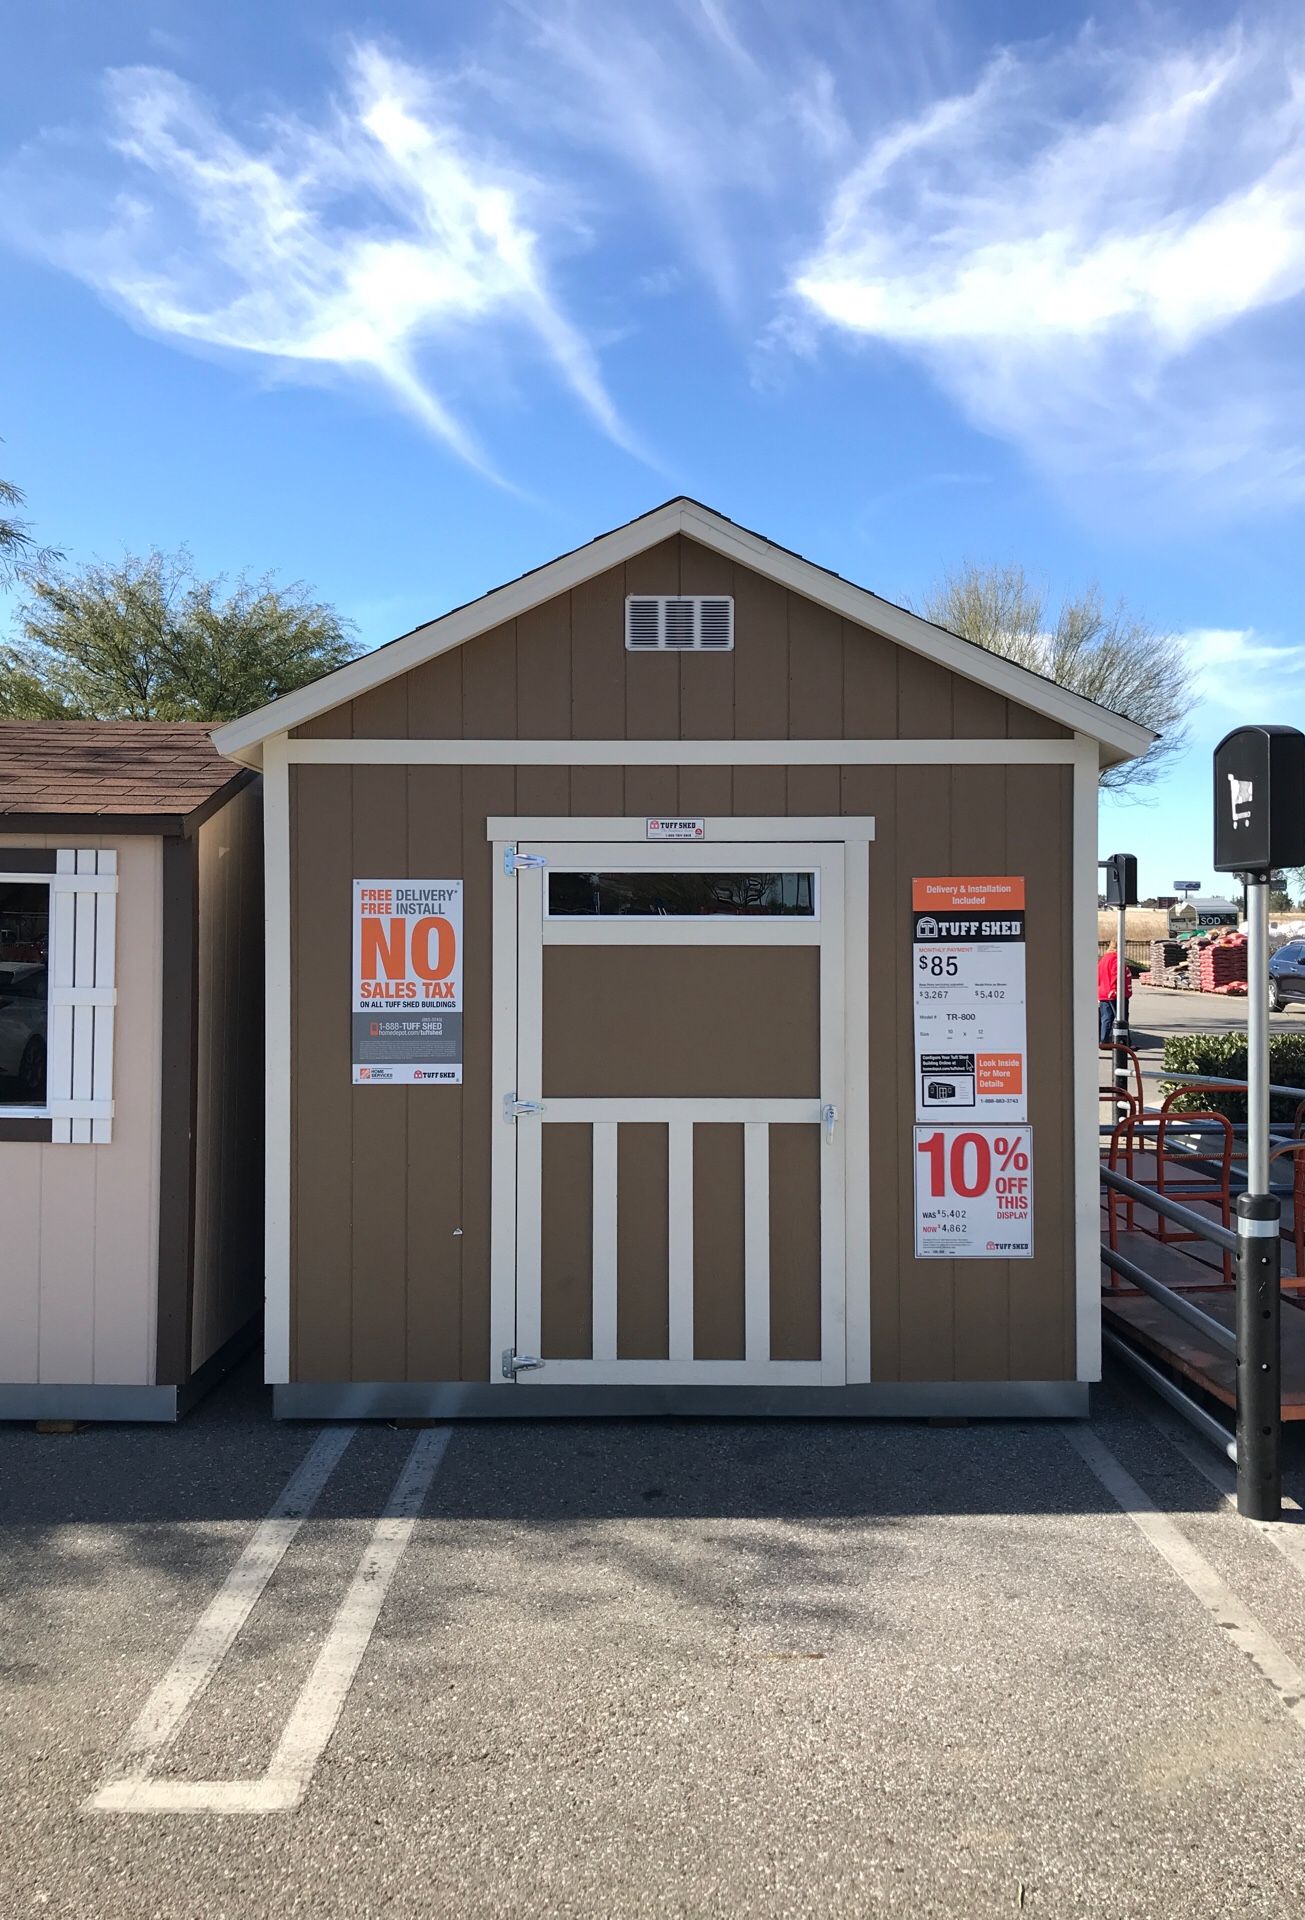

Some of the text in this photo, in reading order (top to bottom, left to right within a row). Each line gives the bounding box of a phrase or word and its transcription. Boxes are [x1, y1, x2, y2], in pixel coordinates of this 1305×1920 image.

[360, 889, 393, 901] FREE
[926, 885, 1011, 895] Delivery & Installation
[952, 896, 986, 905] Included
[360, 902, 446, 915] FREE INSTALL
[1200, 917, 1221, 925] SOD
[938, 921, 1021, 936] TUFF SHED
[360, 916, 456, 981] NO
[919, 955, 958, 976] $85
[360, 981, 455, 999] SALES TAX
[919, 990, 949, 999] $3,267
[974, 990, 1005, 999] $5,402
[946, 1013, 976, 1021] TR-800
[379, 1022, 443, 1031] 1-888-TUFF SHED
[979, 1059, 1020, 1067] Look Inside
[979, 1080, 1004, 1088] Details
[918, 1132, 1029, 1198] 10%
[995, 1177, 1028, 1194] OFF
[996, 1195, 1028, 1210] THIS
[996, 1211, 1028, 1220] DISPLAY
